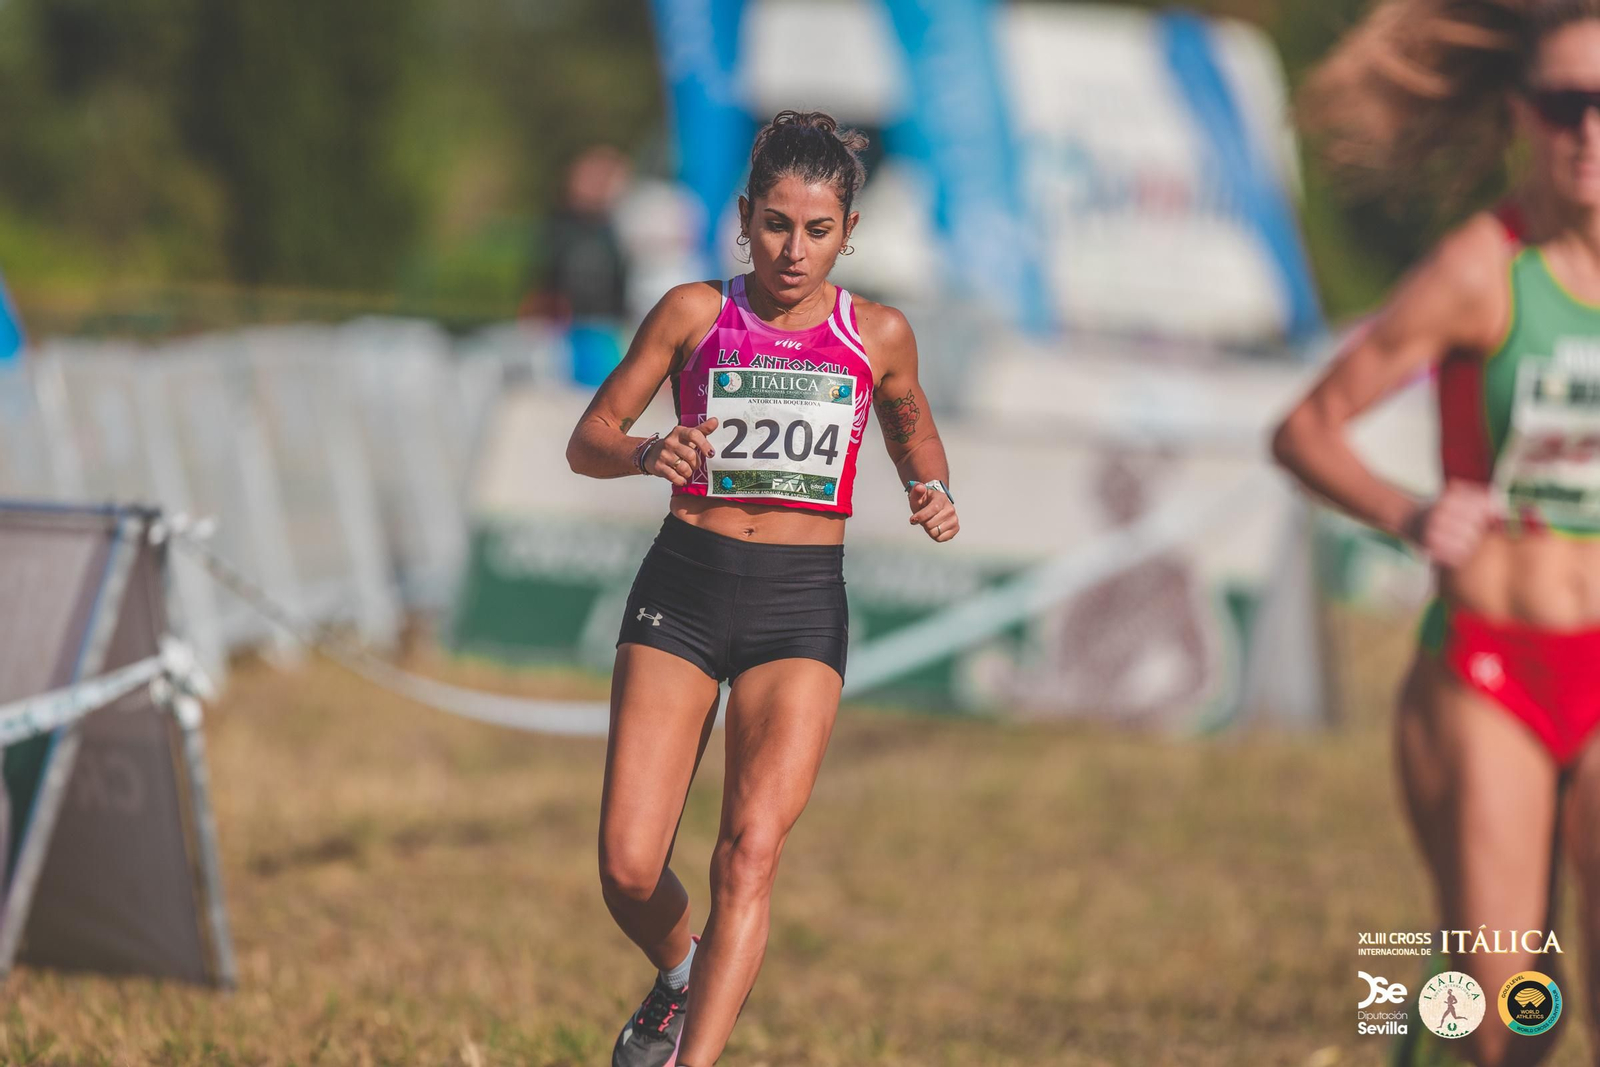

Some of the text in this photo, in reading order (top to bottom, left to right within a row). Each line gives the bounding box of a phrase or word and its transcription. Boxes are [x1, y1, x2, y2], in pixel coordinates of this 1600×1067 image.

[774, 338, 803, 351] vive
[717, 348, 741, 366] LA
[752, 373, 819, 392] ITÁLICA
[720, 418, 839, 466] 2204
